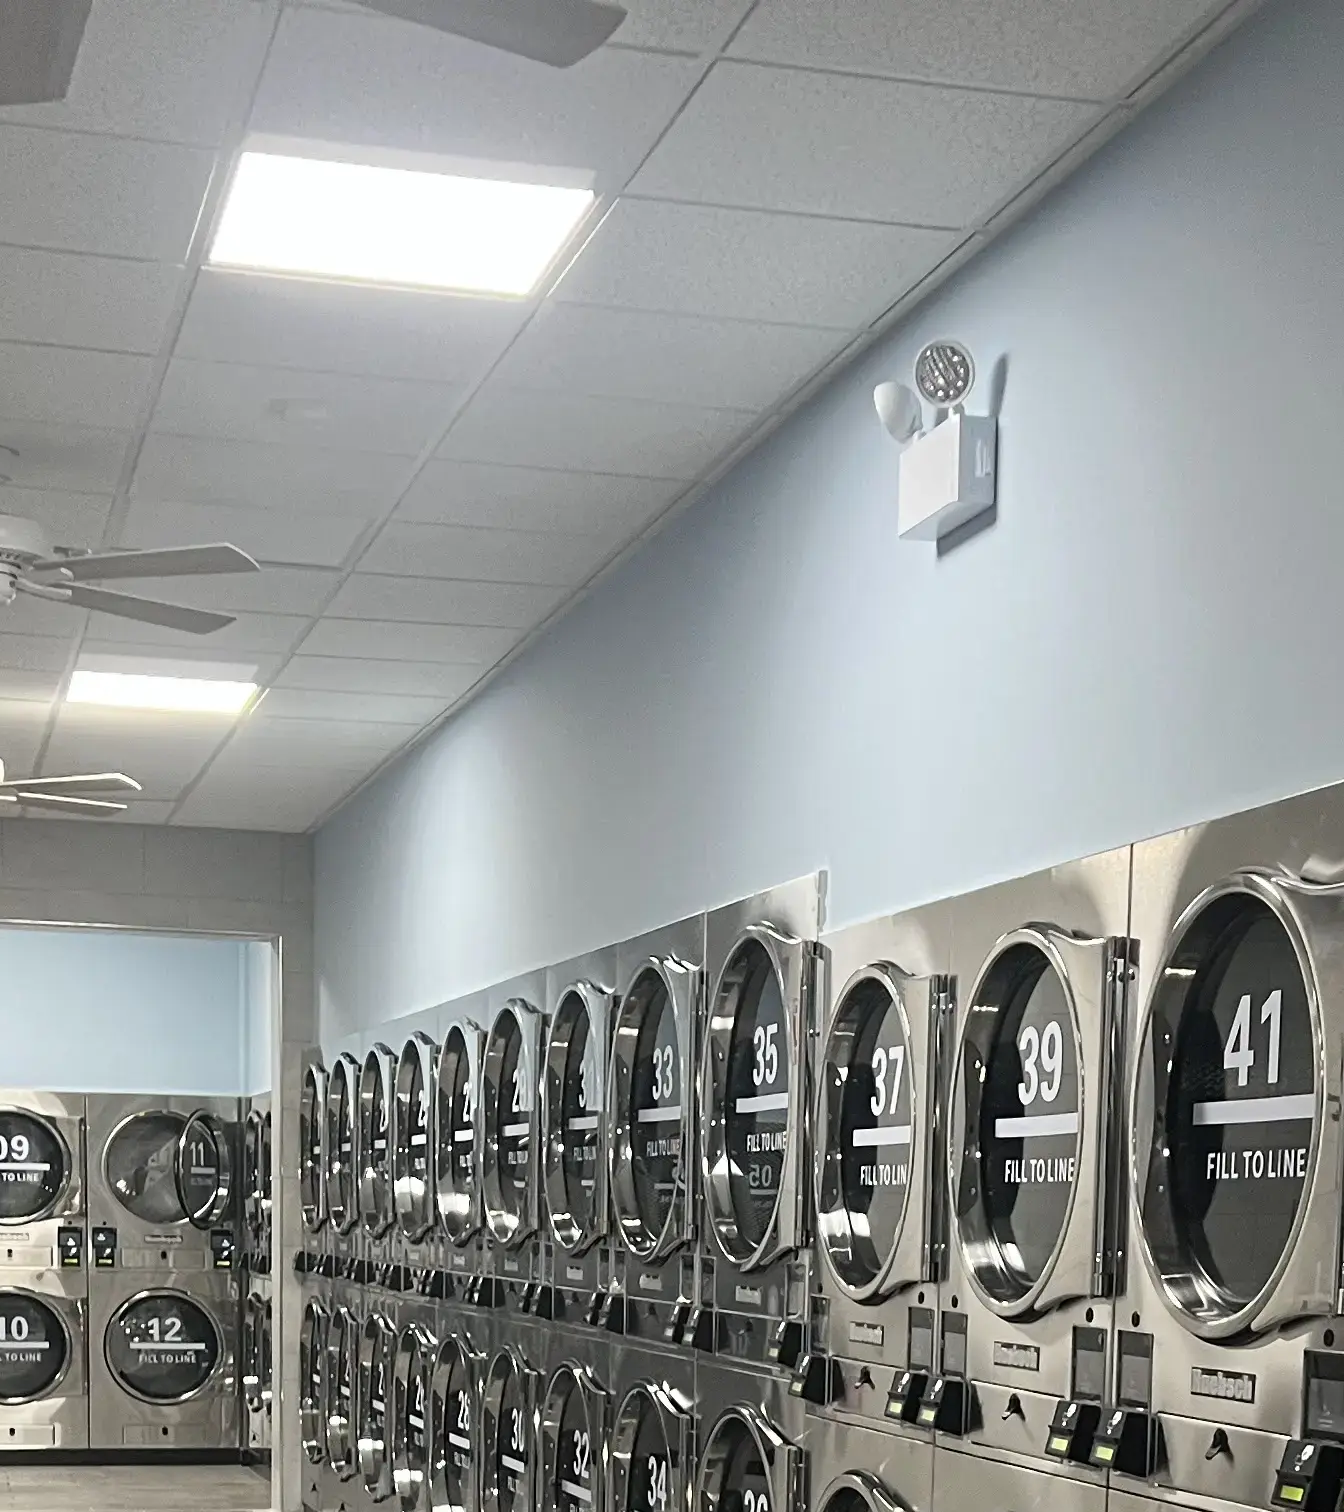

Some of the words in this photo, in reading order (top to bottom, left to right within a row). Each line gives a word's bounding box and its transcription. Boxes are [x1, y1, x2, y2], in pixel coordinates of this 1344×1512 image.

[752, 1022, 778, 1086] 35
[1222, 988, 1283, 1087] 41
[652, 1044, 673, 1100] 33
[1017, 1020, 1064, 1106] 39
[869, 1044, 905, 1117] 37
[189, 1141, 205, 1167] 11
[747, 1134, 760, 1152] FILL
[761, 1132, 770, 1151] TO
[771, 1131, 787, 1151] LINE
[1, 1172, 16, 1182] TO
[17, 1172, 41, 1182] LINE
[859, 1164, 877, 1185] FILL
[878, 1164, 891, 1185] TO
[891, 1163, 908, 1185] LIN
[1004, 1159, 1027, 1183] FILL
[1029, 1158, 1045, 1183] TO
[1047, 1157, 1075, 1182] LINE
[1206, 1151, 1239, 1181] FILL
[1241, 1150, 1264, 1180] TO
[1267, 1147, 1307, 1180] LINE
[147, 1316, 182, 1342] 12
[5, 1352, 18, 1362] TO
[19, 1352, 42, 1362] LINE
[573, 1429, 590, 1479] 32
[647, 1455, 667, 1512] 34
